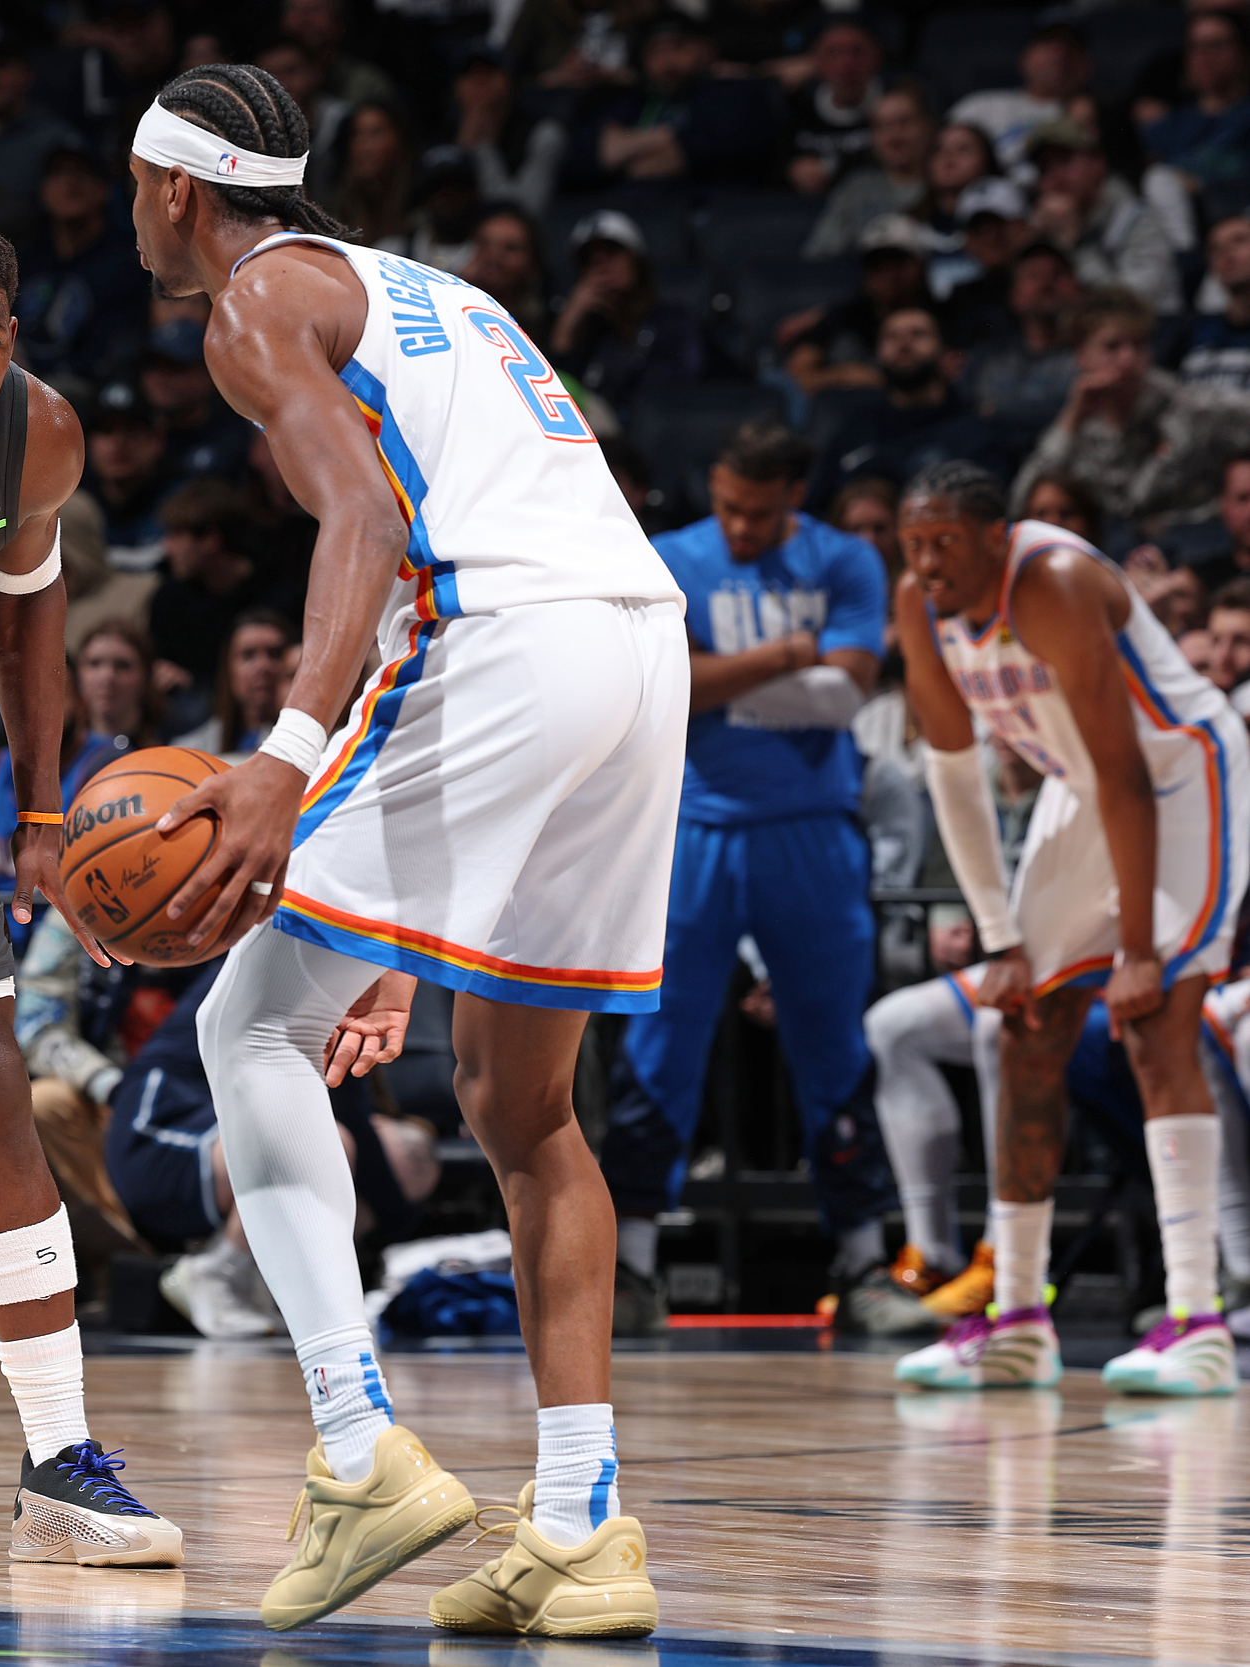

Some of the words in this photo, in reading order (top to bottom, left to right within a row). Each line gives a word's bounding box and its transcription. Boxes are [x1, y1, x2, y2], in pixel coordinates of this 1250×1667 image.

[461, 305, 598, 443] 2
[59, 794, 145, 864] ilson
[36, 1246, 57, 1265] 5
